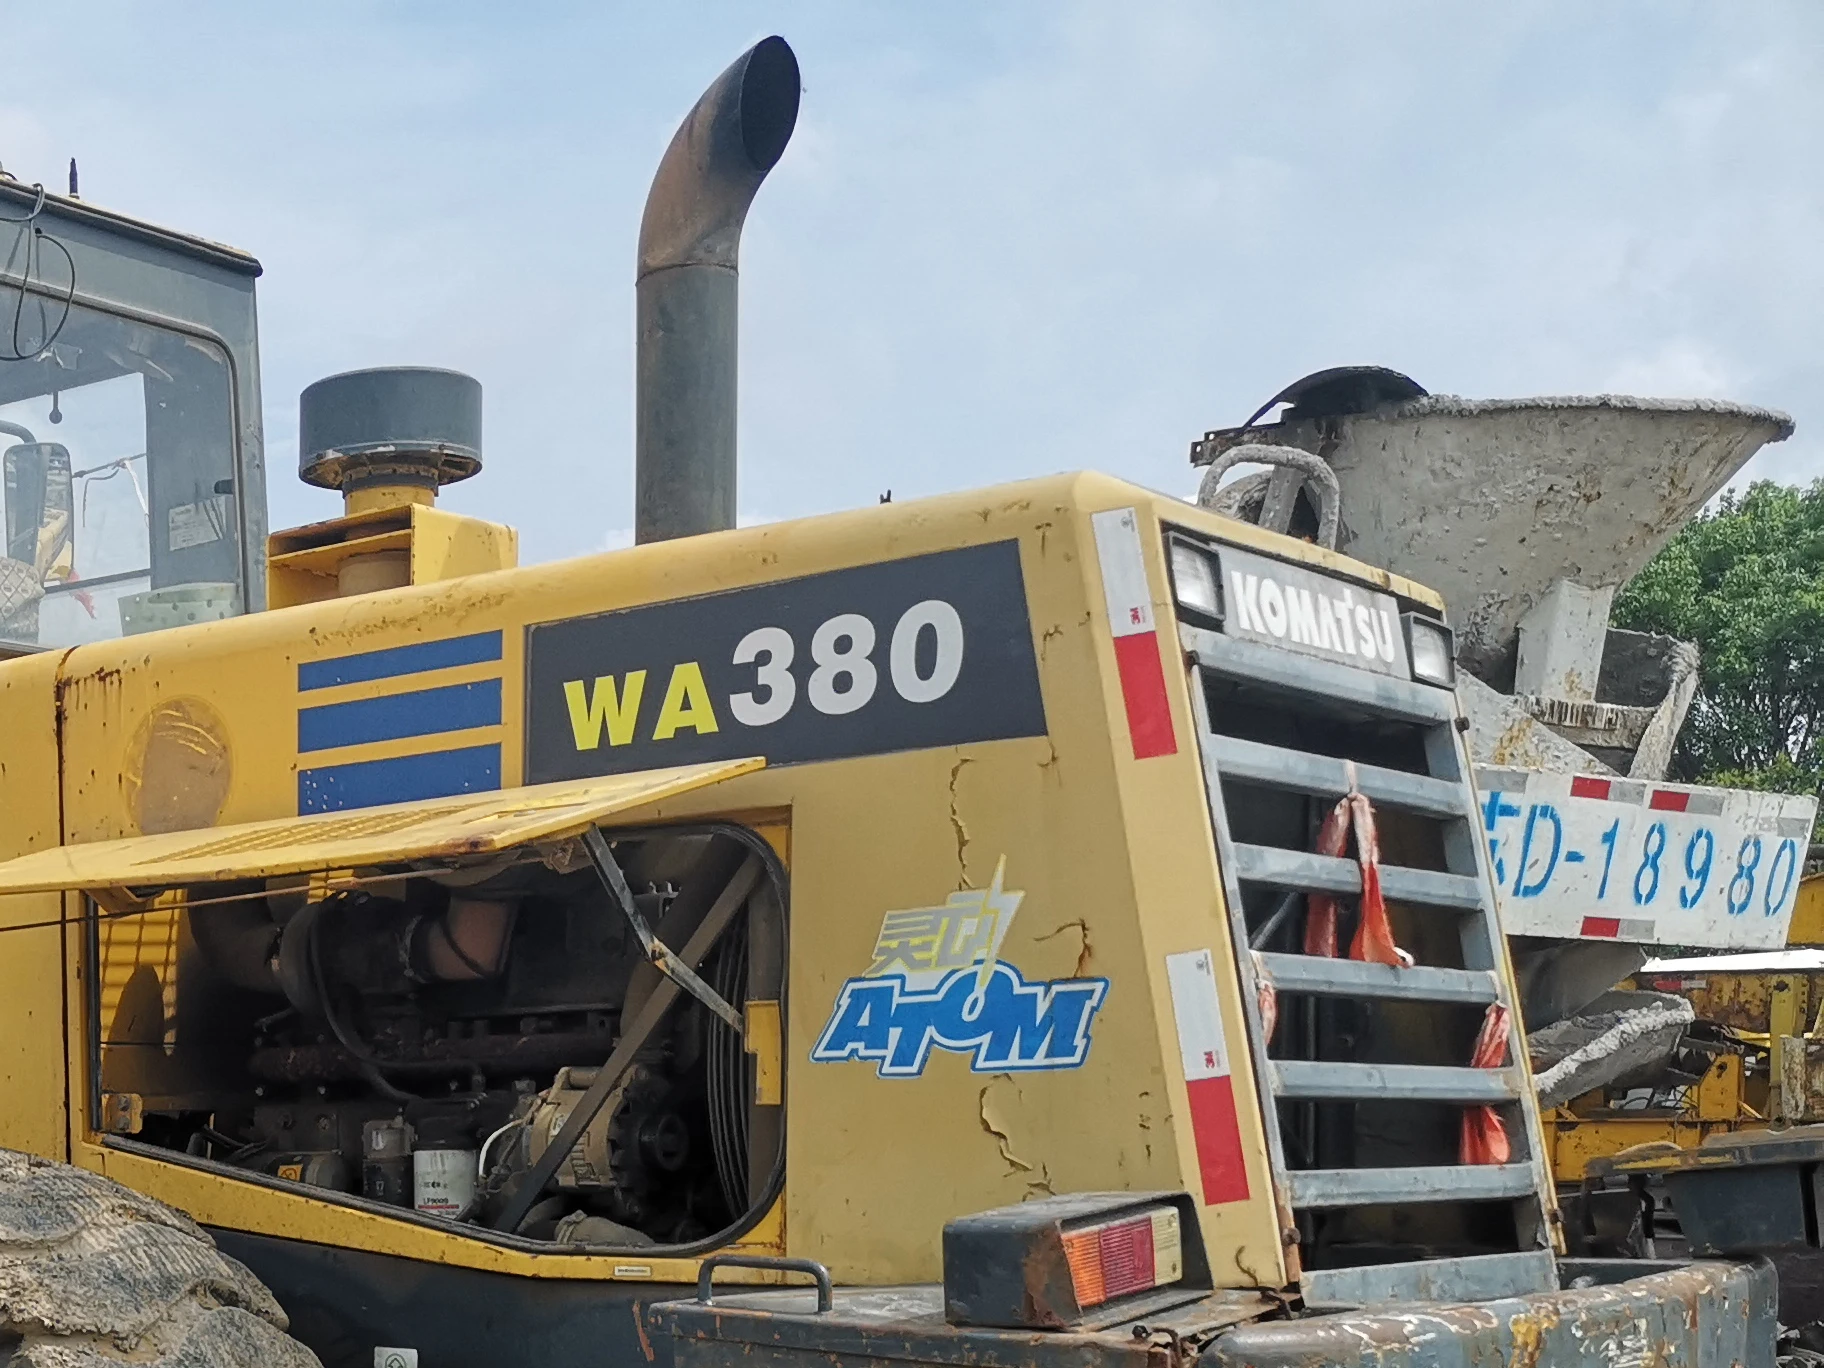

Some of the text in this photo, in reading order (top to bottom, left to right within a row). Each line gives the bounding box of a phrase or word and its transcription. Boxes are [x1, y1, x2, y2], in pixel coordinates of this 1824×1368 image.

[1129, 606, 1141, 626] 3M
[1231, 570, 1396, 663] KOMATSU
[809, 958, 1111, 1080] ATOM
[1203, 1050, 1216, 1069] 3M
